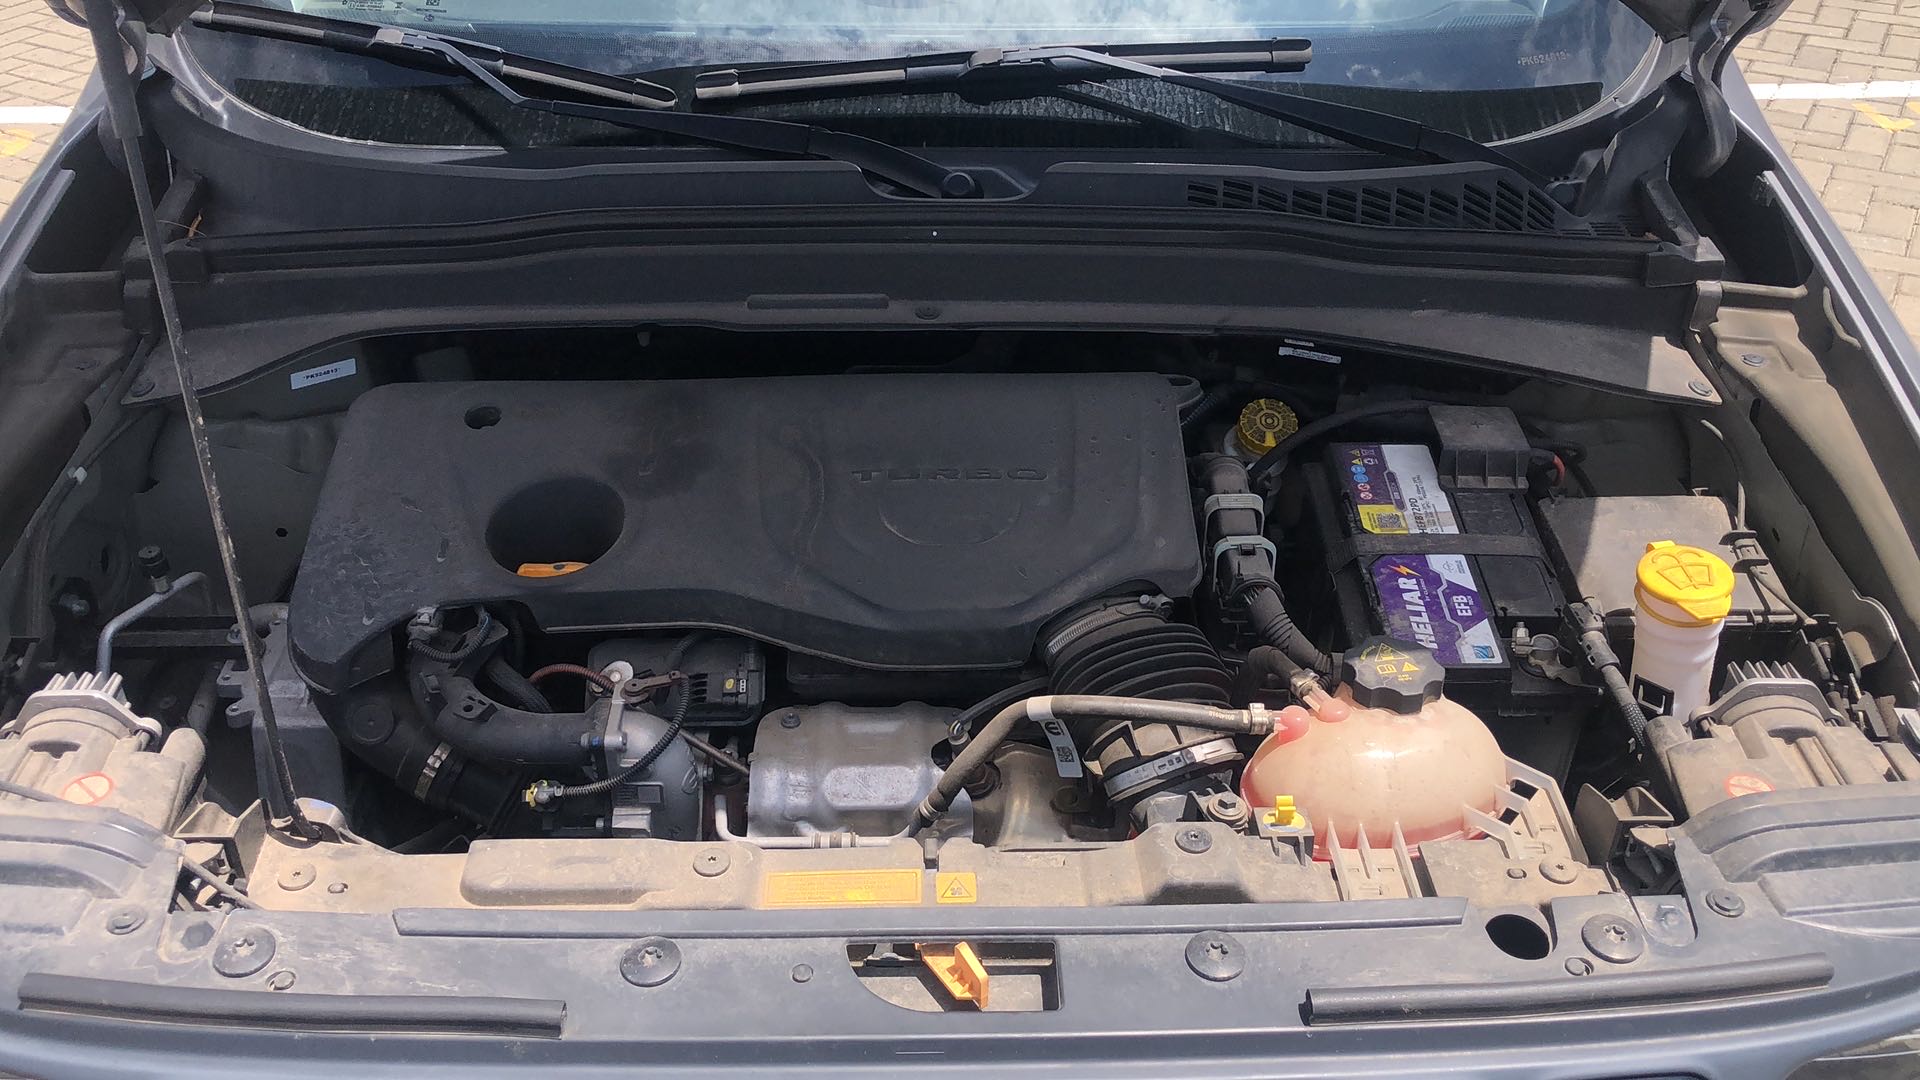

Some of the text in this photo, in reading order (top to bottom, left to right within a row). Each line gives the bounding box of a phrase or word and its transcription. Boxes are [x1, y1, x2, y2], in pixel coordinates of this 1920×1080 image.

[850, 468, 1049, 483] TURBO
[1397, 577, 1439, 650] HELIAR
[1452, 595, 1473, 617] EFB
